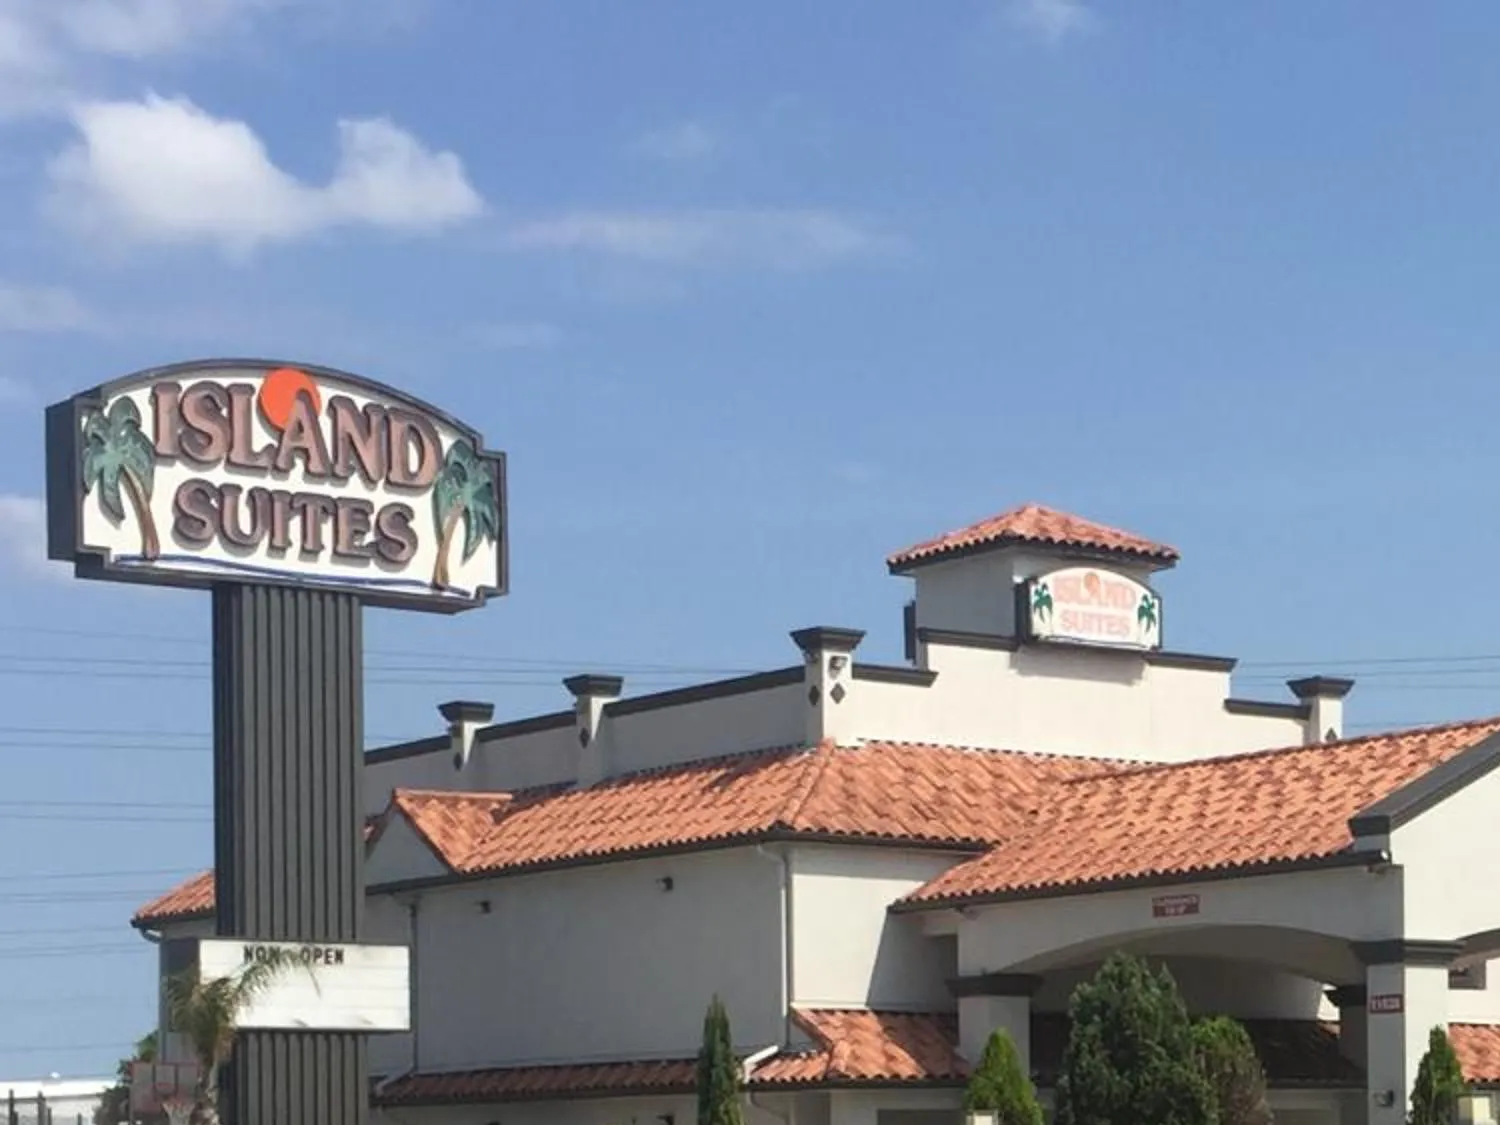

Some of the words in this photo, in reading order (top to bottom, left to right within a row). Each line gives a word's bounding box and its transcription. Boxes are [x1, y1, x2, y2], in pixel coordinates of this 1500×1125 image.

[151, 379, 445, 491] ISLAND
[172, 478, 417, 568] SUITES
[1053, 575, 1137, 609] ISLAND
[1060, 609, 1131, 636] SUITES
[301, 947, 345, 965] OPEN
